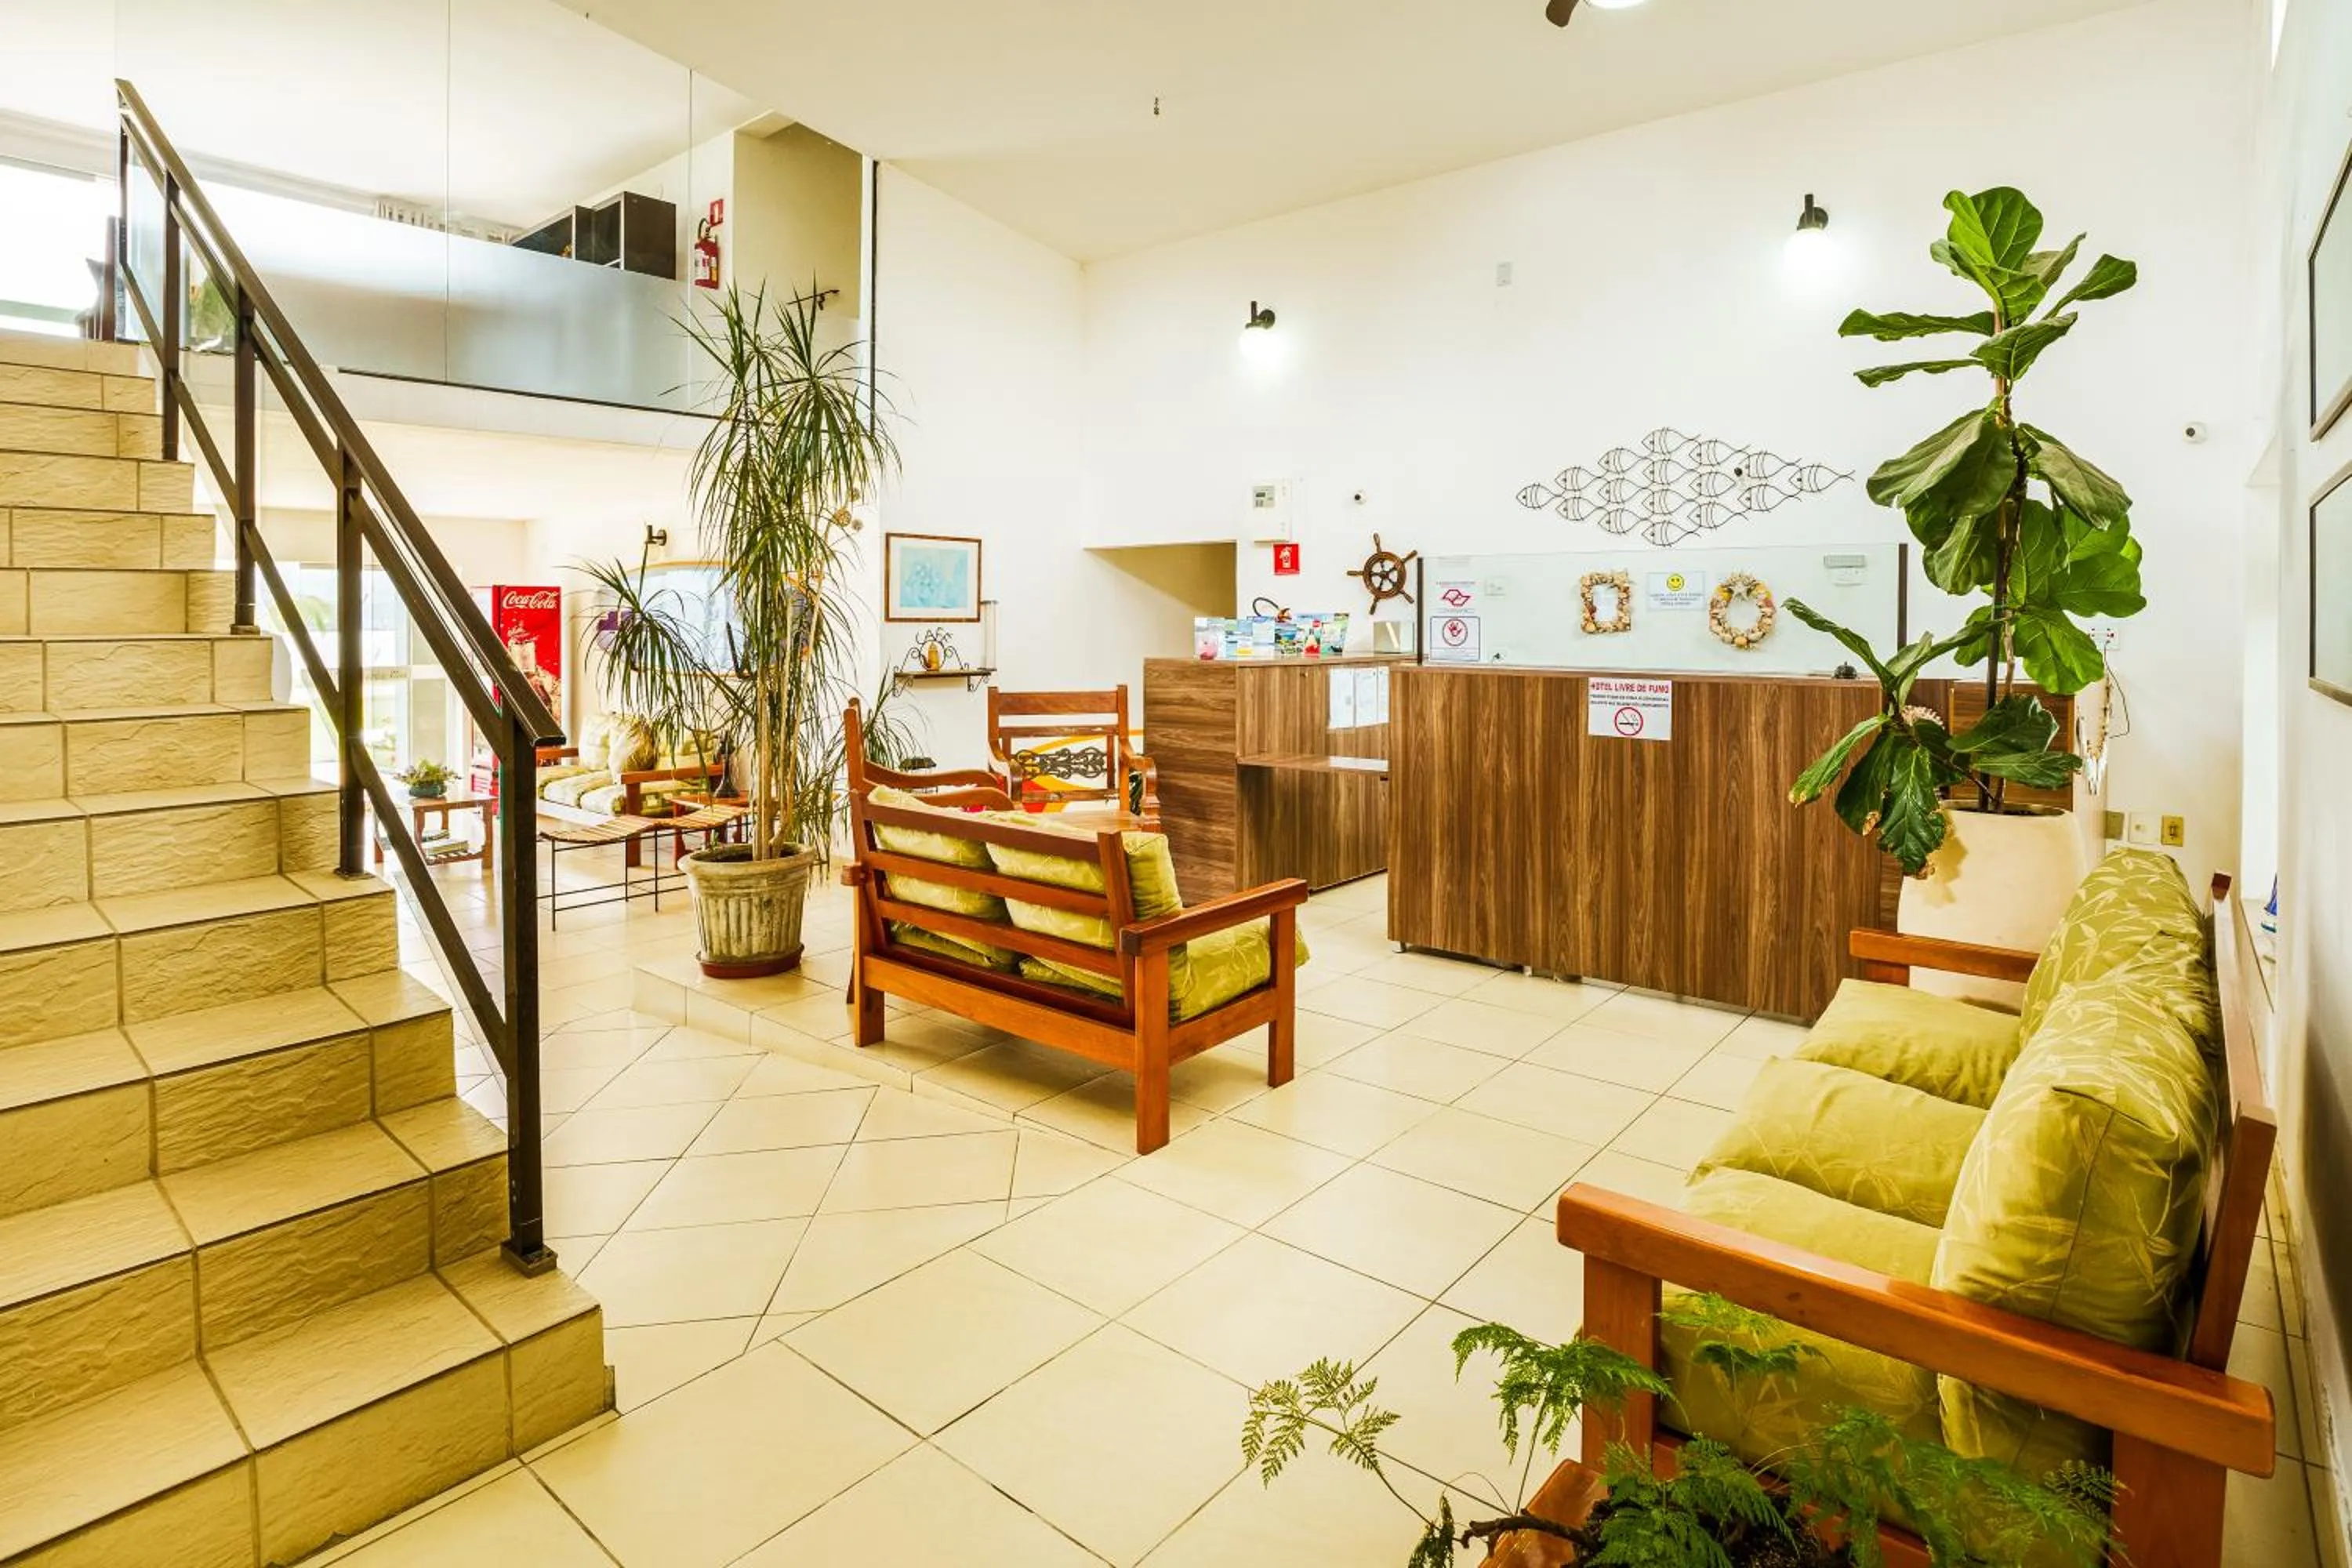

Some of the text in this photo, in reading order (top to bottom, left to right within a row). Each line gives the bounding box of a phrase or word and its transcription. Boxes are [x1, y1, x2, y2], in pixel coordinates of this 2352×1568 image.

[503, 590, 558, 609] Coca-Cola
[1591, 682, 1669, 694] HOTEL LIVRE DE FUMO
